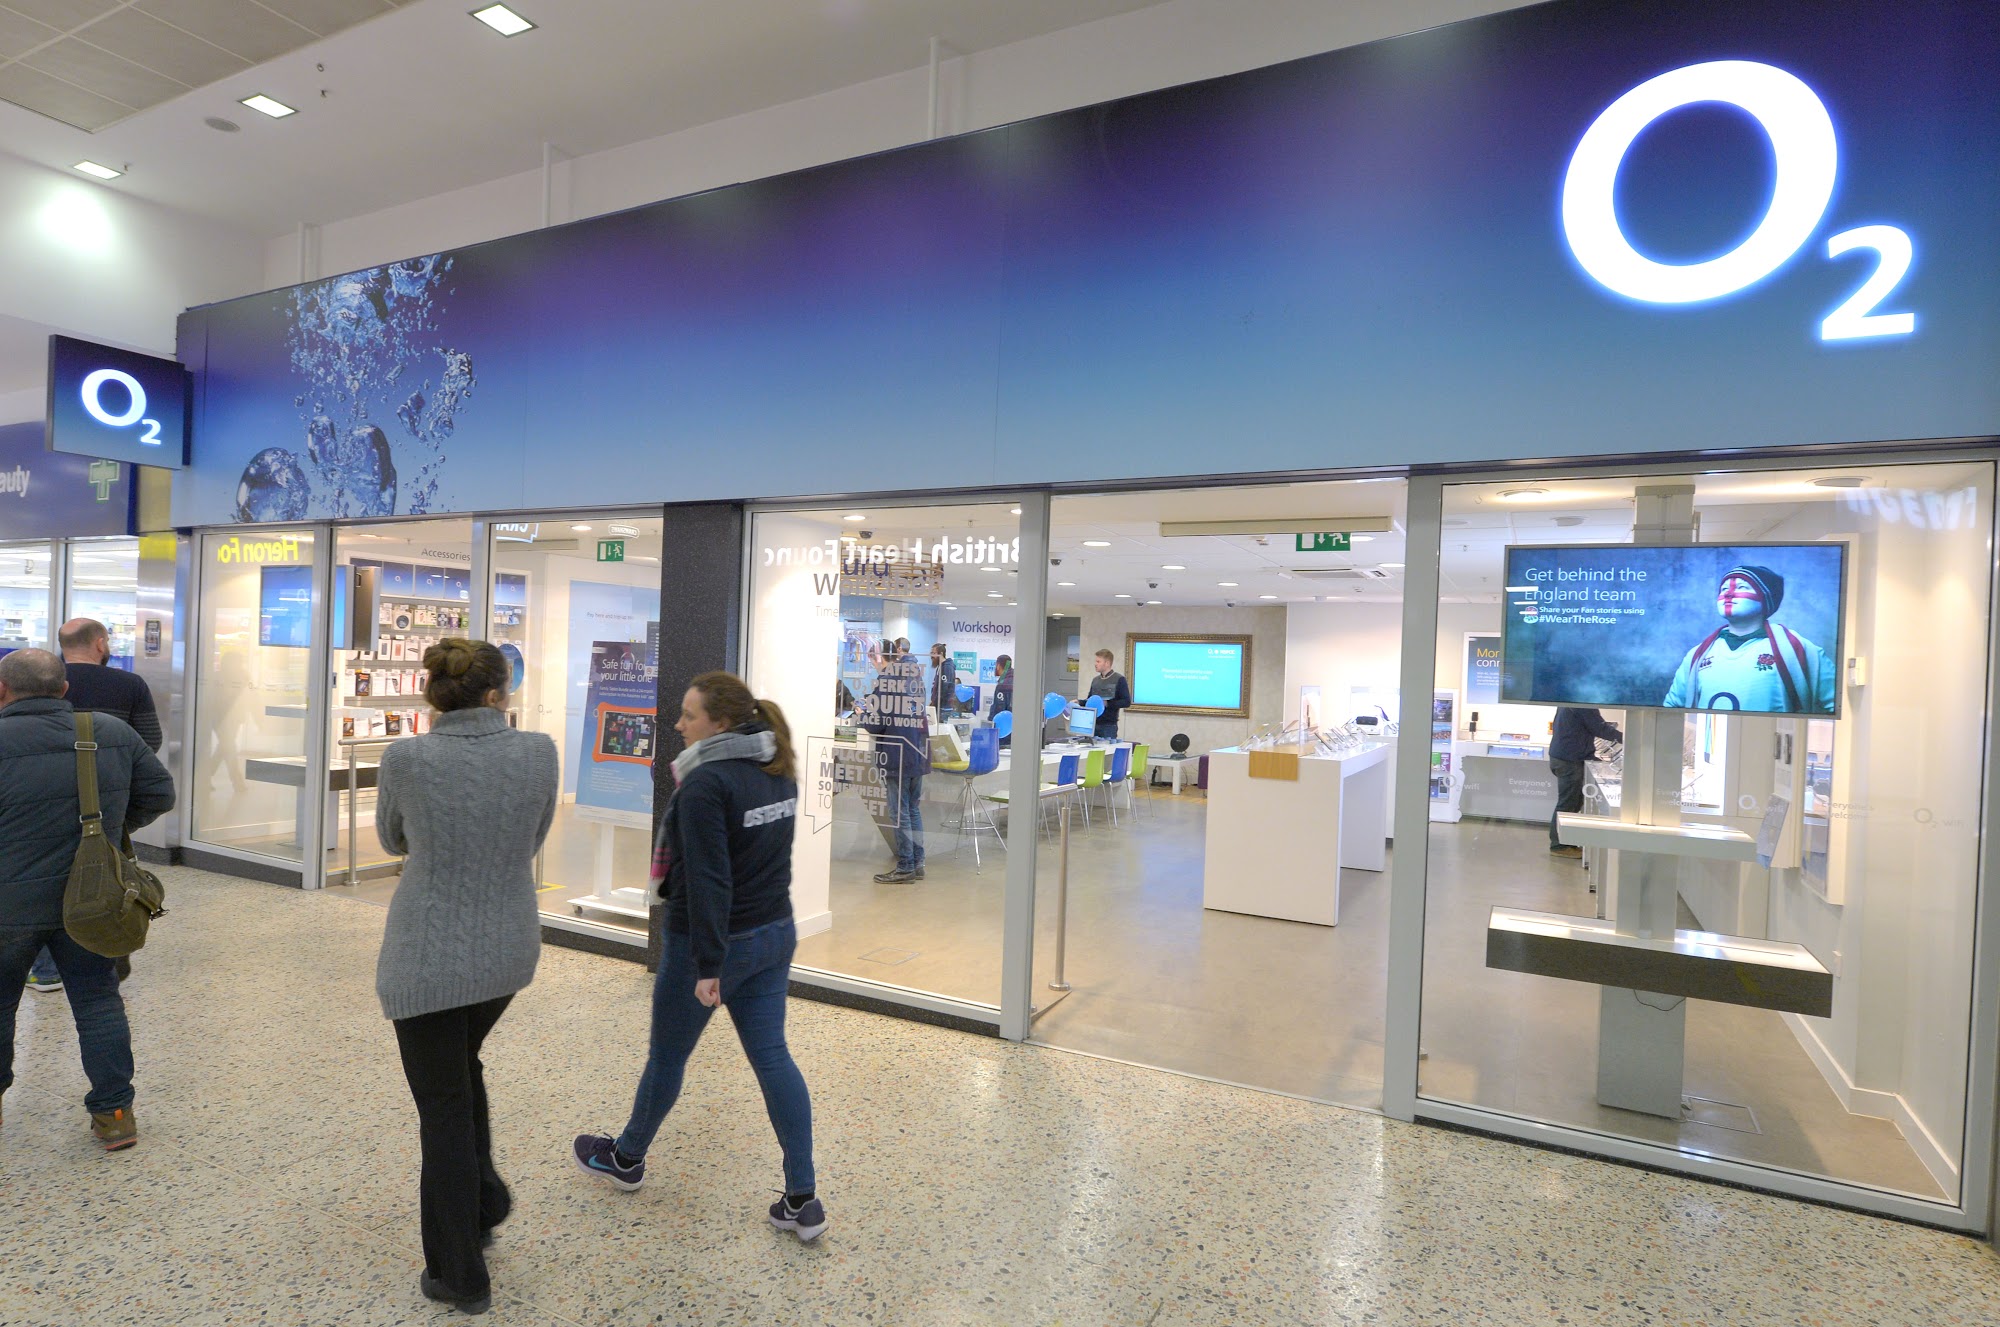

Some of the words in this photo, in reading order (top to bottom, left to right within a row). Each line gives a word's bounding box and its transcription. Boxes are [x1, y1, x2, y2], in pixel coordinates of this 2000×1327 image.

[1561, 59, 1915, 341] O2
[80, 368, 163, 446] O2
[420, 547, 471, 562] Accessories
[1525, 567, 1554, 582] Get
[1558, 567, 1614, 582] behind
[1618, 567, 1647, 582] the
[1524, 586, 1589, 604] England
[1593, 588, 1636, 601] team
[1539, 606, 1560, 614] Share
[1562, 608, 1580, 616] your
[1623, 607, 1645, 616] using
[1538, 614, 1617, 625] #WearTheRose
[952, 620, 1012, 637] Workshop
[1476, 648, 1500, 658] Mor
[601, 659, 619, 670] Safe
[620, 660, 634, 671] fun
[879, 662, 927, 677] LATEST
[600, 672, 618, 683] your
[620, 671, 636, 682] little
[637, 674, 653, 683] one
[871, 678, 906, 693] PERK
[865, 693, 925, 716] QUIET
[881, 715, 892, 727] TO
[893, 717, 924, 729] WORK
[821, 746, 828, 758] A
[874, 751, 888, 766] TO
[820, 761, 865, 783] MEET
[867, 766, 888, 786] OR
[1463, 783, 1480, 791] wifi
[1508, 778, 1552, 789] Everyone's
[1511, 787, 1548, 797] welcome
[1606, 793, 1622, 801] wif
[817, 793, 832, 810] TO
